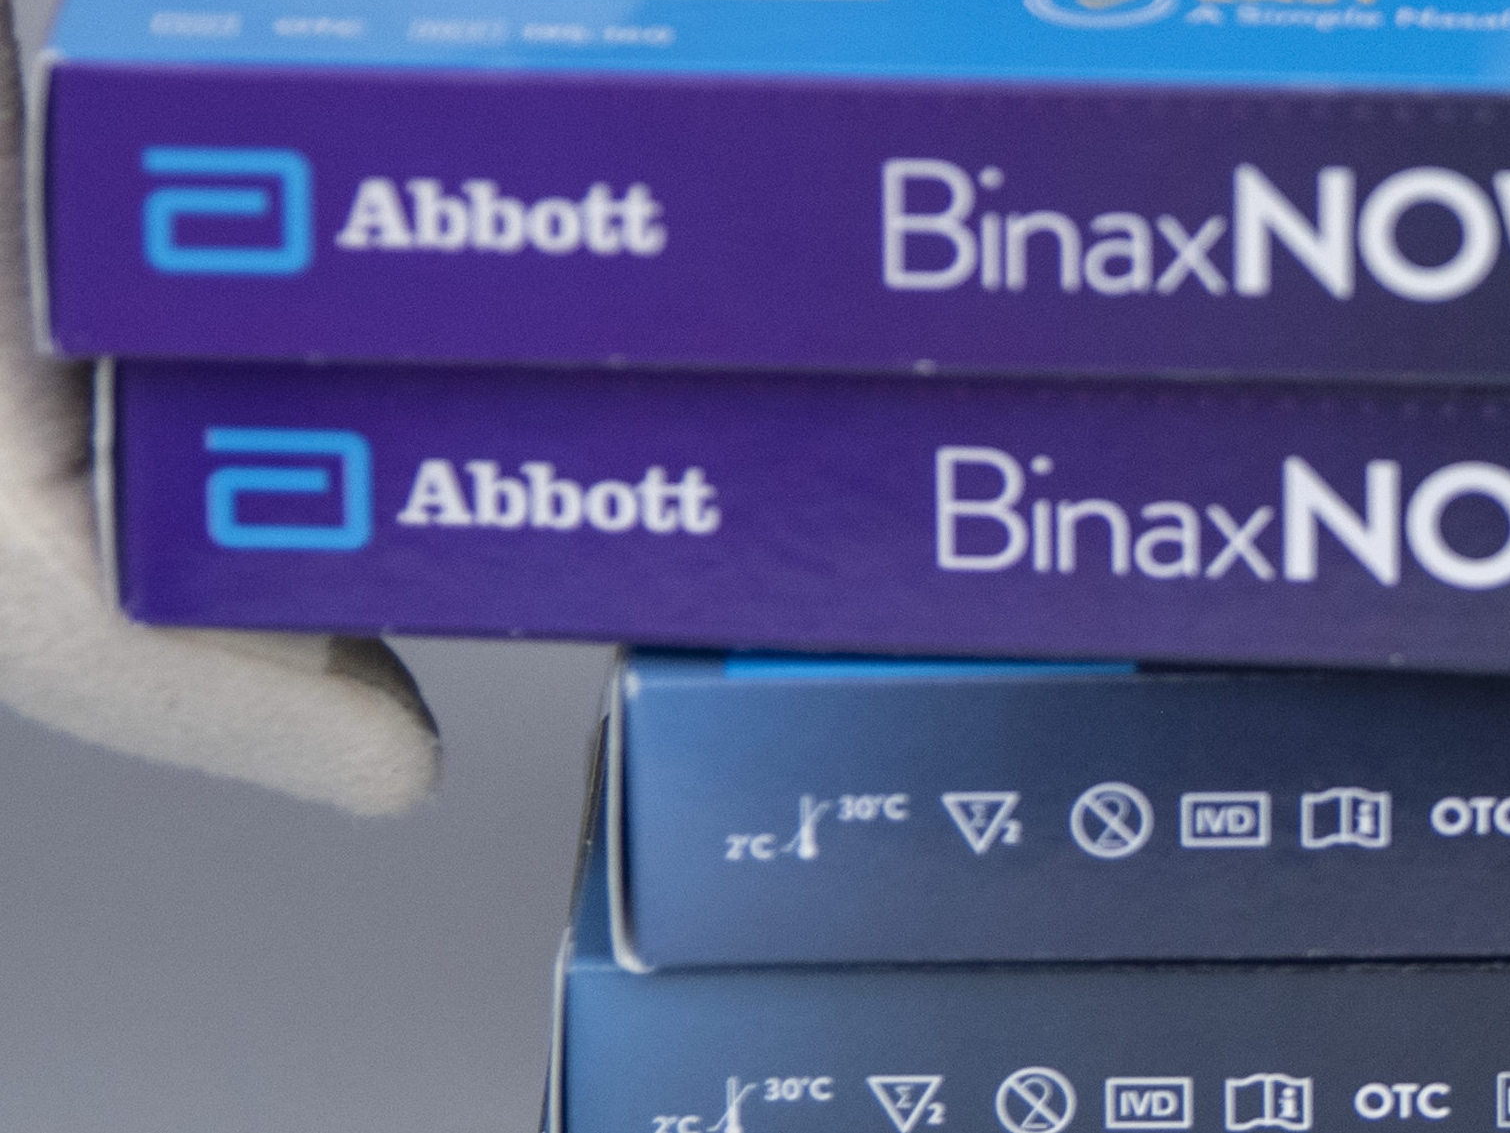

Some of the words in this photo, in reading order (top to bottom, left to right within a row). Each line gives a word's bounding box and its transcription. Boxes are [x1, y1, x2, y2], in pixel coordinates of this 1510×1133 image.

[337, 176, 667, 256] Abbott
[396, 458, 721, 536] Abbott
[1195, 805, 1254, 835] IVD
[1119, 1091, 1176, 1117] IVD
[1353, 1082, 1451, 1120] OTC
